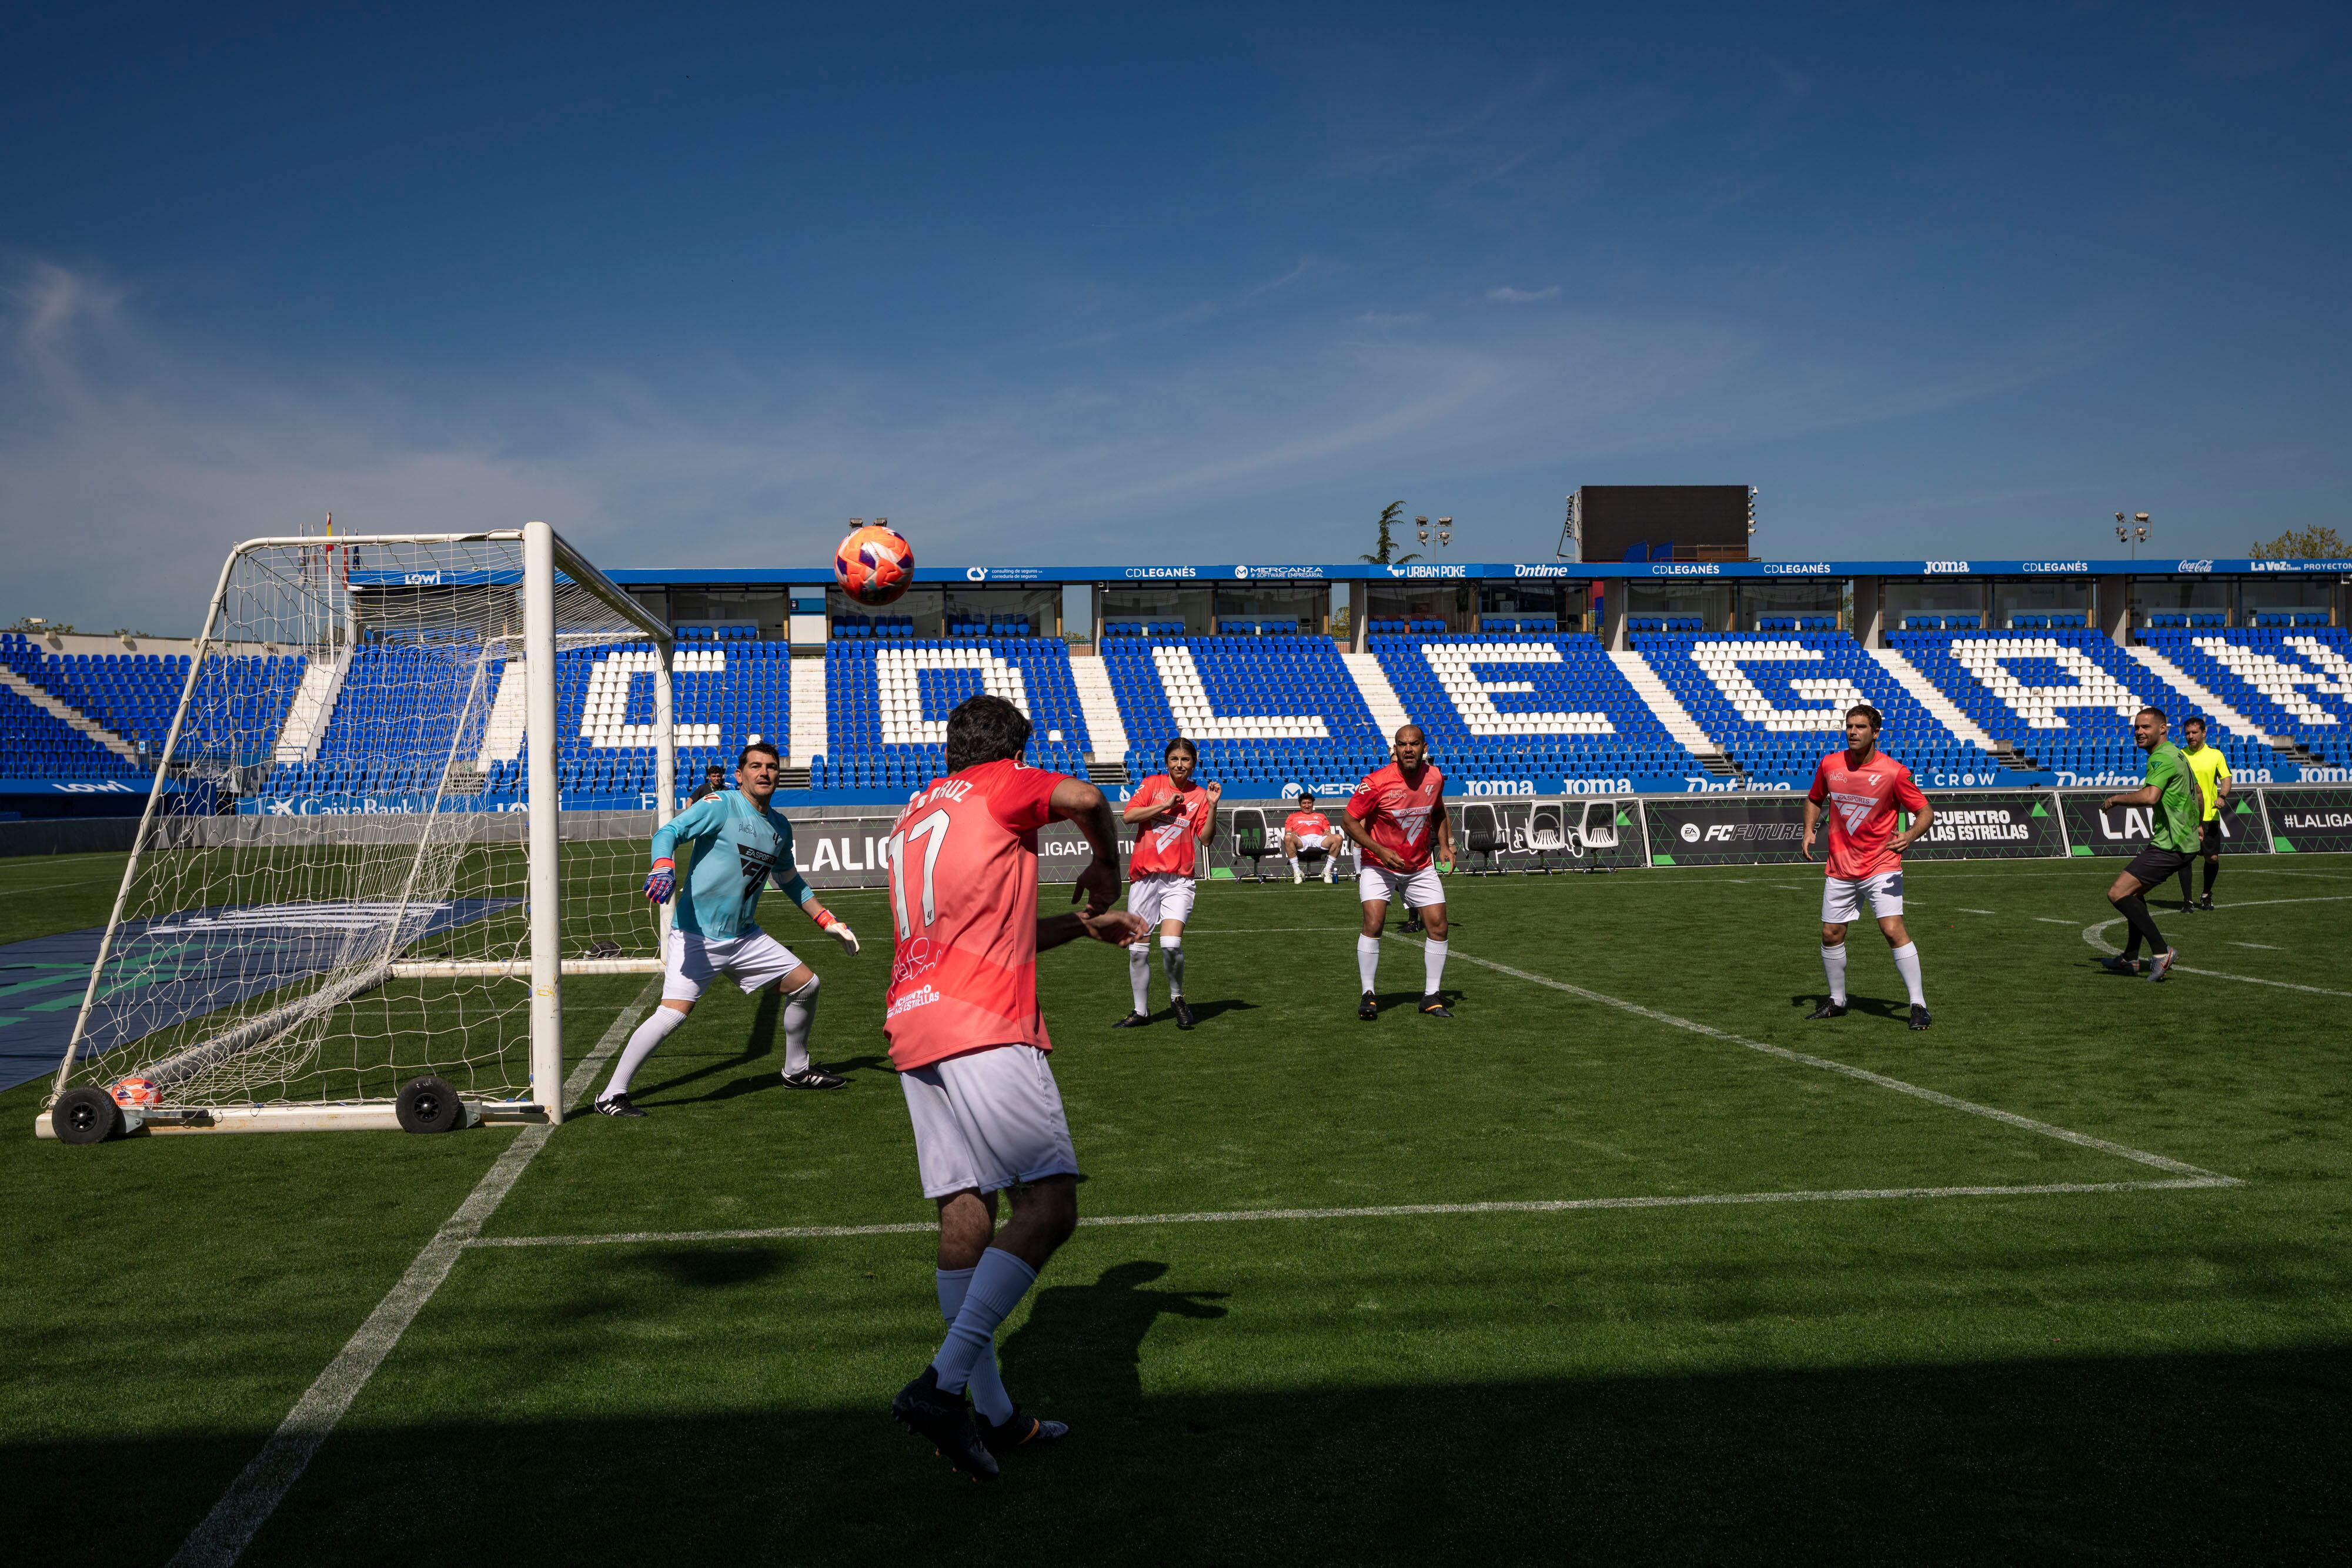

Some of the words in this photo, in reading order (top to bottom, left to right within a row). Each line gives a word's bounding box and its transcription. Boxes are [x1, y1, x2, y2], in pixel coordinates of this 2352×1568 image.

[1407, 566, 1439, 578] URBAN
[1441, 566, 1466, 578] POKE
[1514, 564, 1568, 577] Ontime
[2178, 559, 2214, 573] Coca-Cola
[2251, 561, 2264, 571] La
[1935, 773, 1996, 787] CROW
[1847, 795, 1870, 804] SPORTS
[1929, 826, 1956, 842] LAS
[1957, 824, 2029, 841] ESTRELLAS
[756, 852, 775, 864] SPORTS
[888, 808, 951, 944] 17
